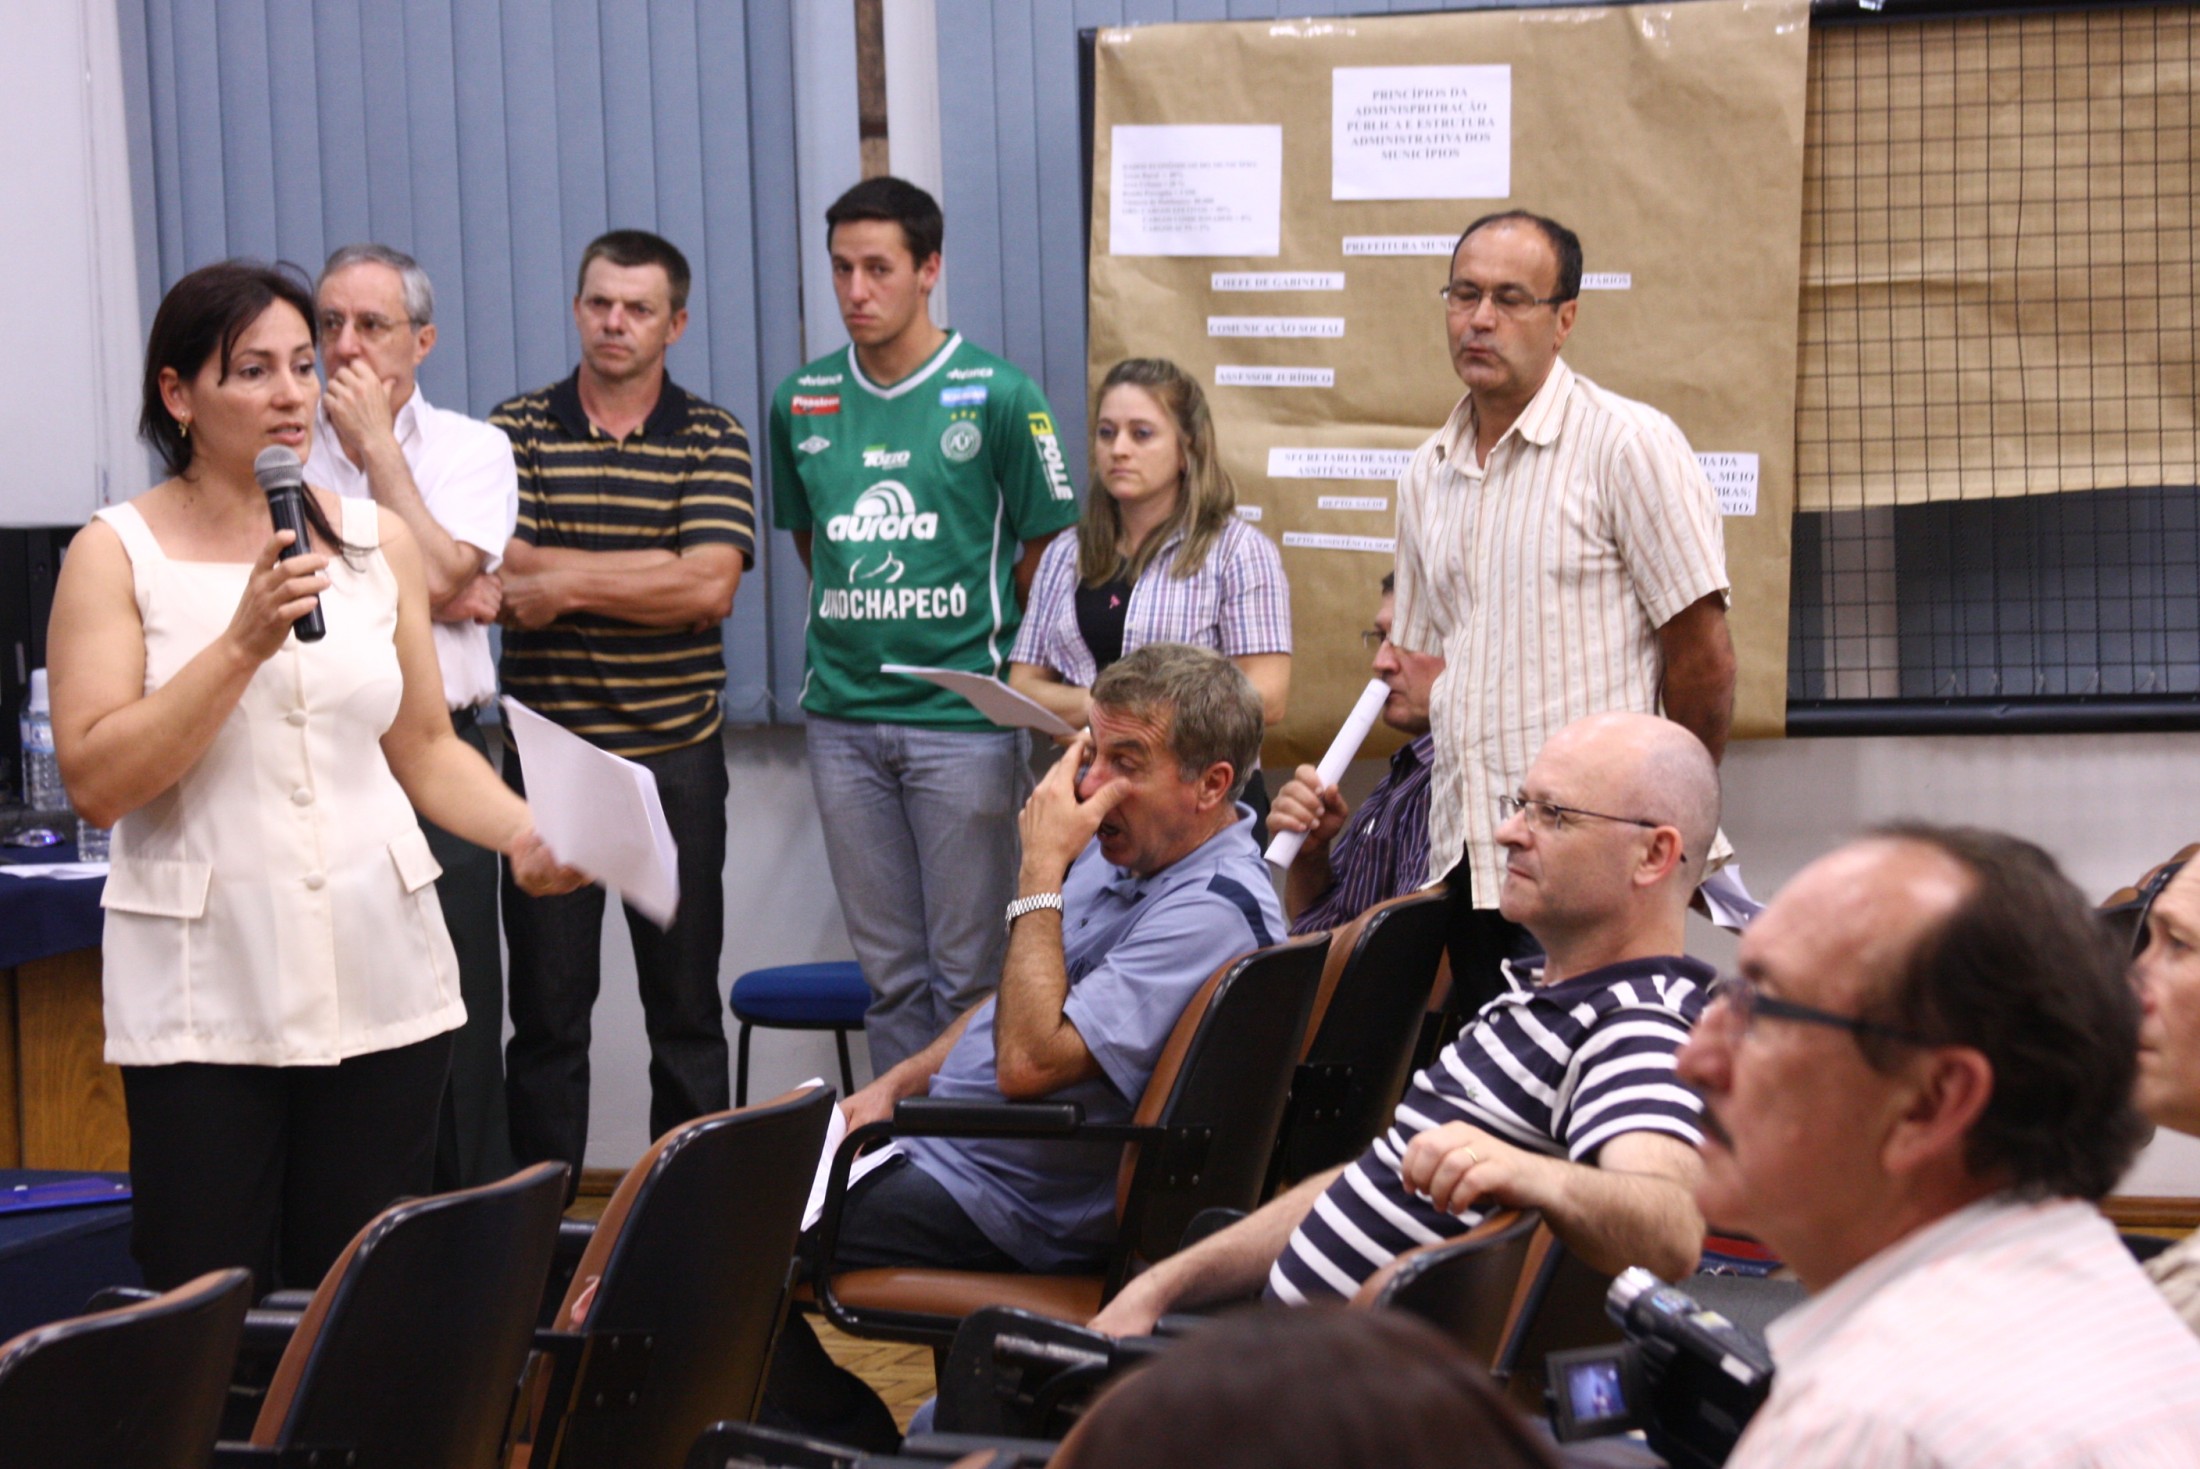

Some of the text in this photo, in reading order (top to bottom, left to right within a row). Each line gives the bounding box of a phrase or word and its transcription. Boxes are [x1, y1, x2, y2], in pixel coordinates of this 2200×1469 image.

[1372, 87, 1468, 100] PRINCÍPIOS DA
[1417, 117, 1495, 129] ESTRUTURA
[1351, 132, 1491, 146] ADMINISTRATIVA DOS
[1381, 147, 1460, 160] MUNICÍPIOS
[1345, 241, 1417, 251] PREFEITURA
[1214, 277, 1331, 287] CHEFE DE GABINETE
[1210, 322, 1340, 335] COMUNICAÇÃO SOCIAL
[1220, 372, 1332, 383] ASSESSOR JURÍDICO
[1285, 453, 1357, 463] SECRETARIA
[1360, 454, 1373, 463] DE
[1720, 457, 1737, 466] DA
[1720, 472, 1754, 482] MEIO
[826, 512, 938, 541] aurora
[819, 582, 967, 620] UNOCHAPECÓ
